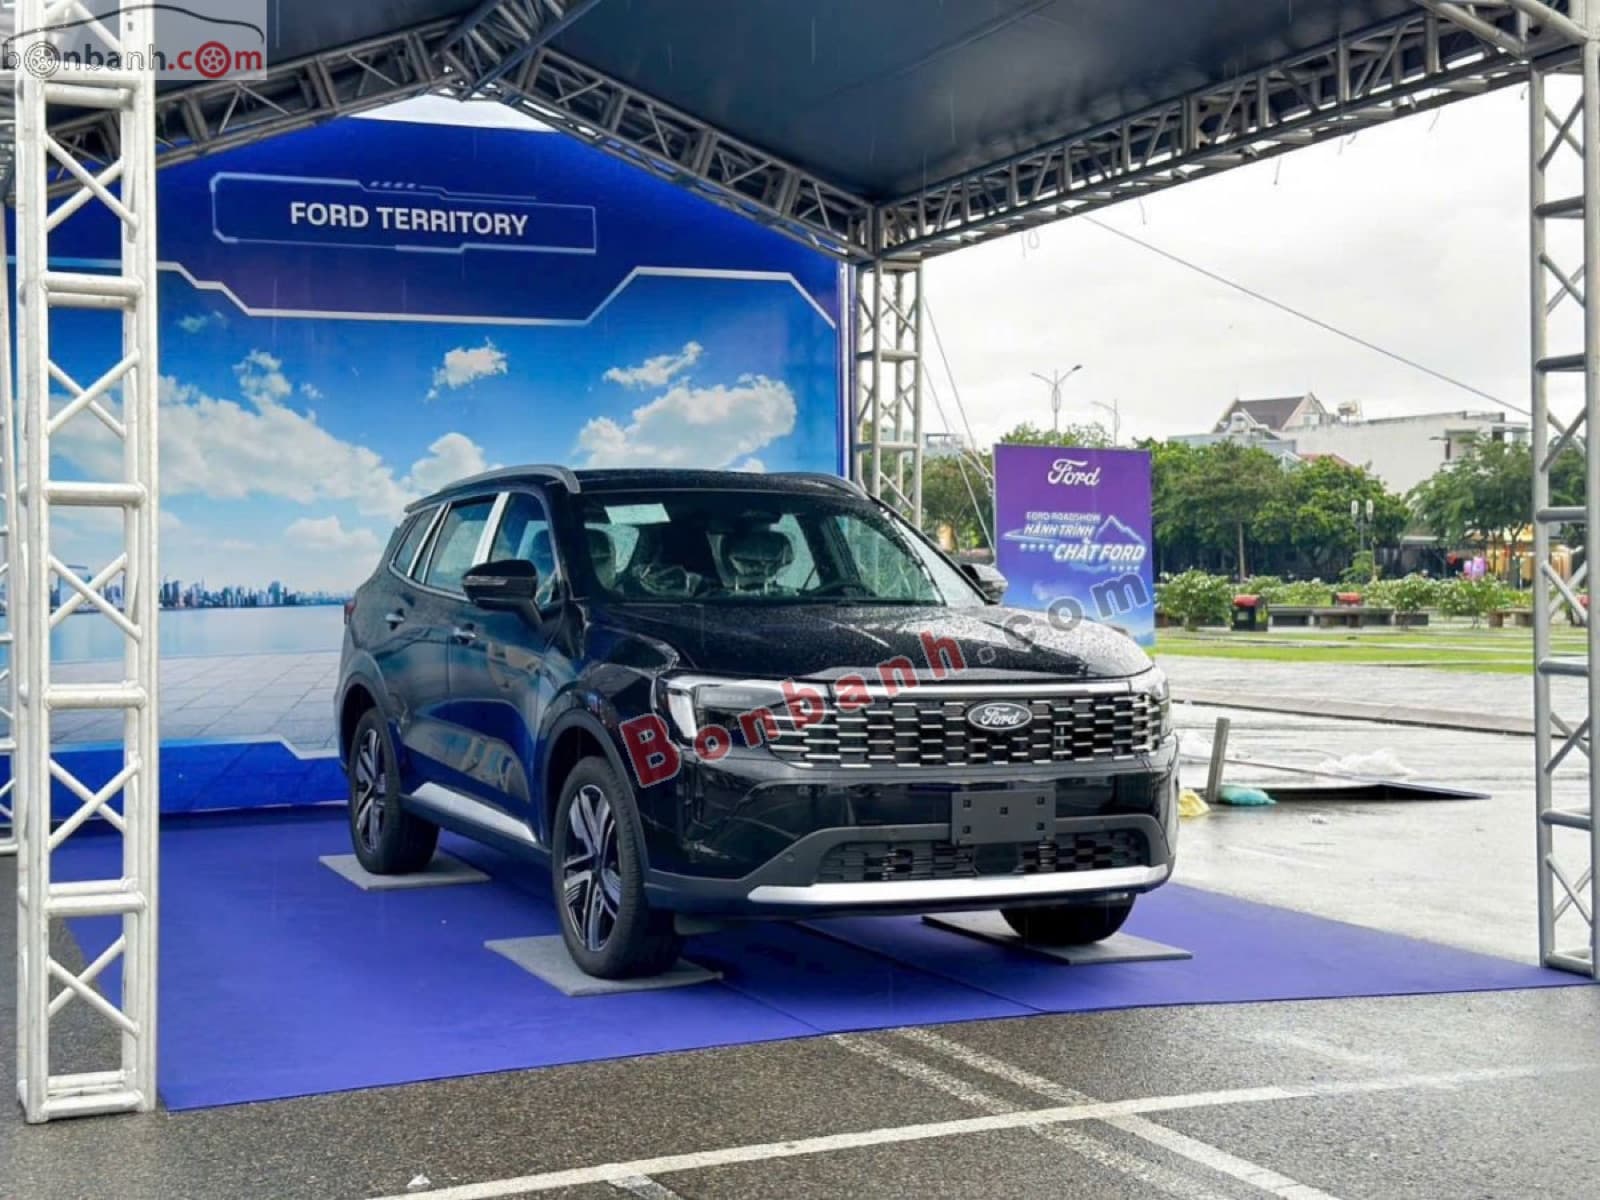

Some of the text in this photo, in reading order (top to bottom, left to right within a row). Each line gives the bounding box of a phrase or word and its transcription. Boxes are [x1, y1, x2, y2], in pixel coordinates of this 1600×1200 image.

[290, 202, 528, 236] FORD TERRITORY
[1047, 458, 1101, 486] Ford
[1099, 544, 1146, 561] FORD
[980, 707, 1021, 726] Ford
